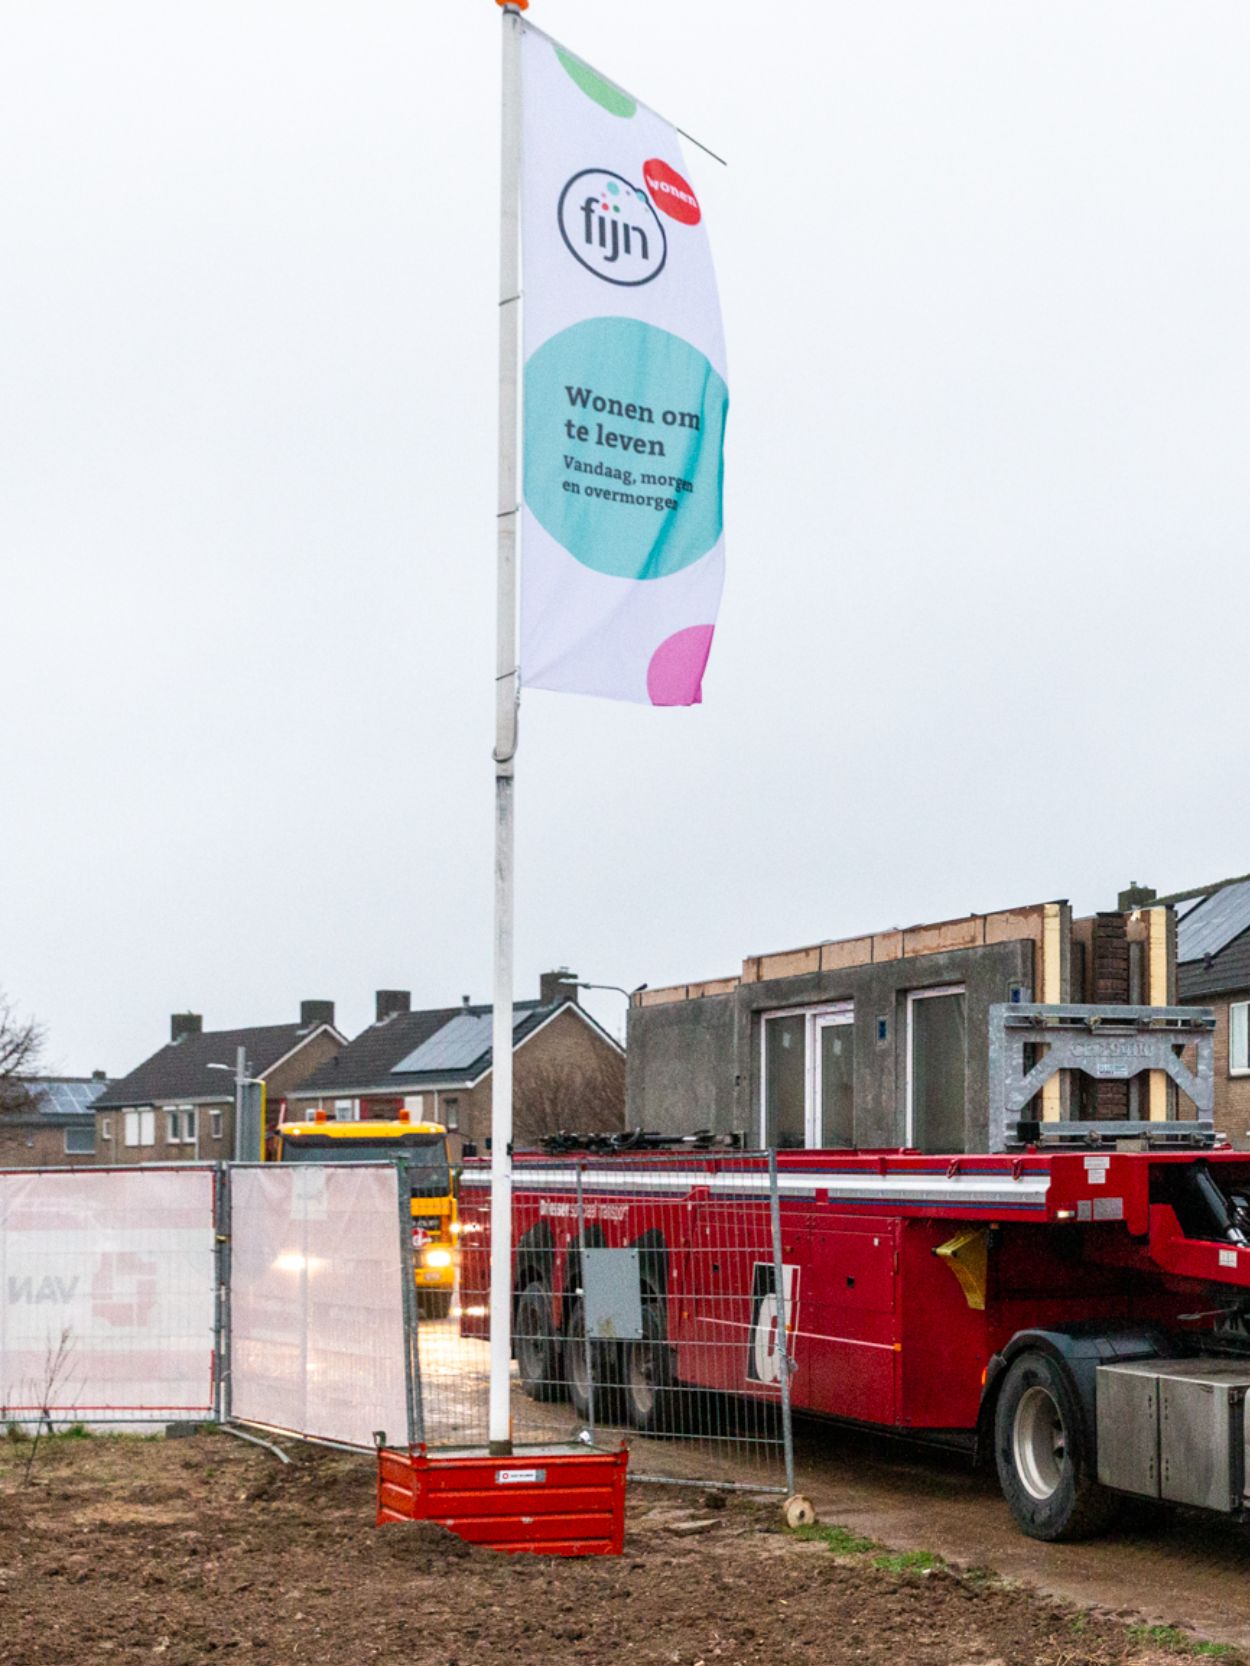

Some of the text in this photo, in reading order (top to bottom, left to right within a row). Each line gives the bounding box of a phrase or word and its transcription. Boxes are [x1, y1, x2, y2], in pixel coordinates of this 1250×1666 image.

[646, 175, 698, 208] wonen
[580, 196, 649, 263] fijn
[564, 385, 701, 432] Wonen om
[564, 419, 666, 457] te leven
[562, 480, 581, 495] en
[563, 455, 637, 486] Vandaag,
